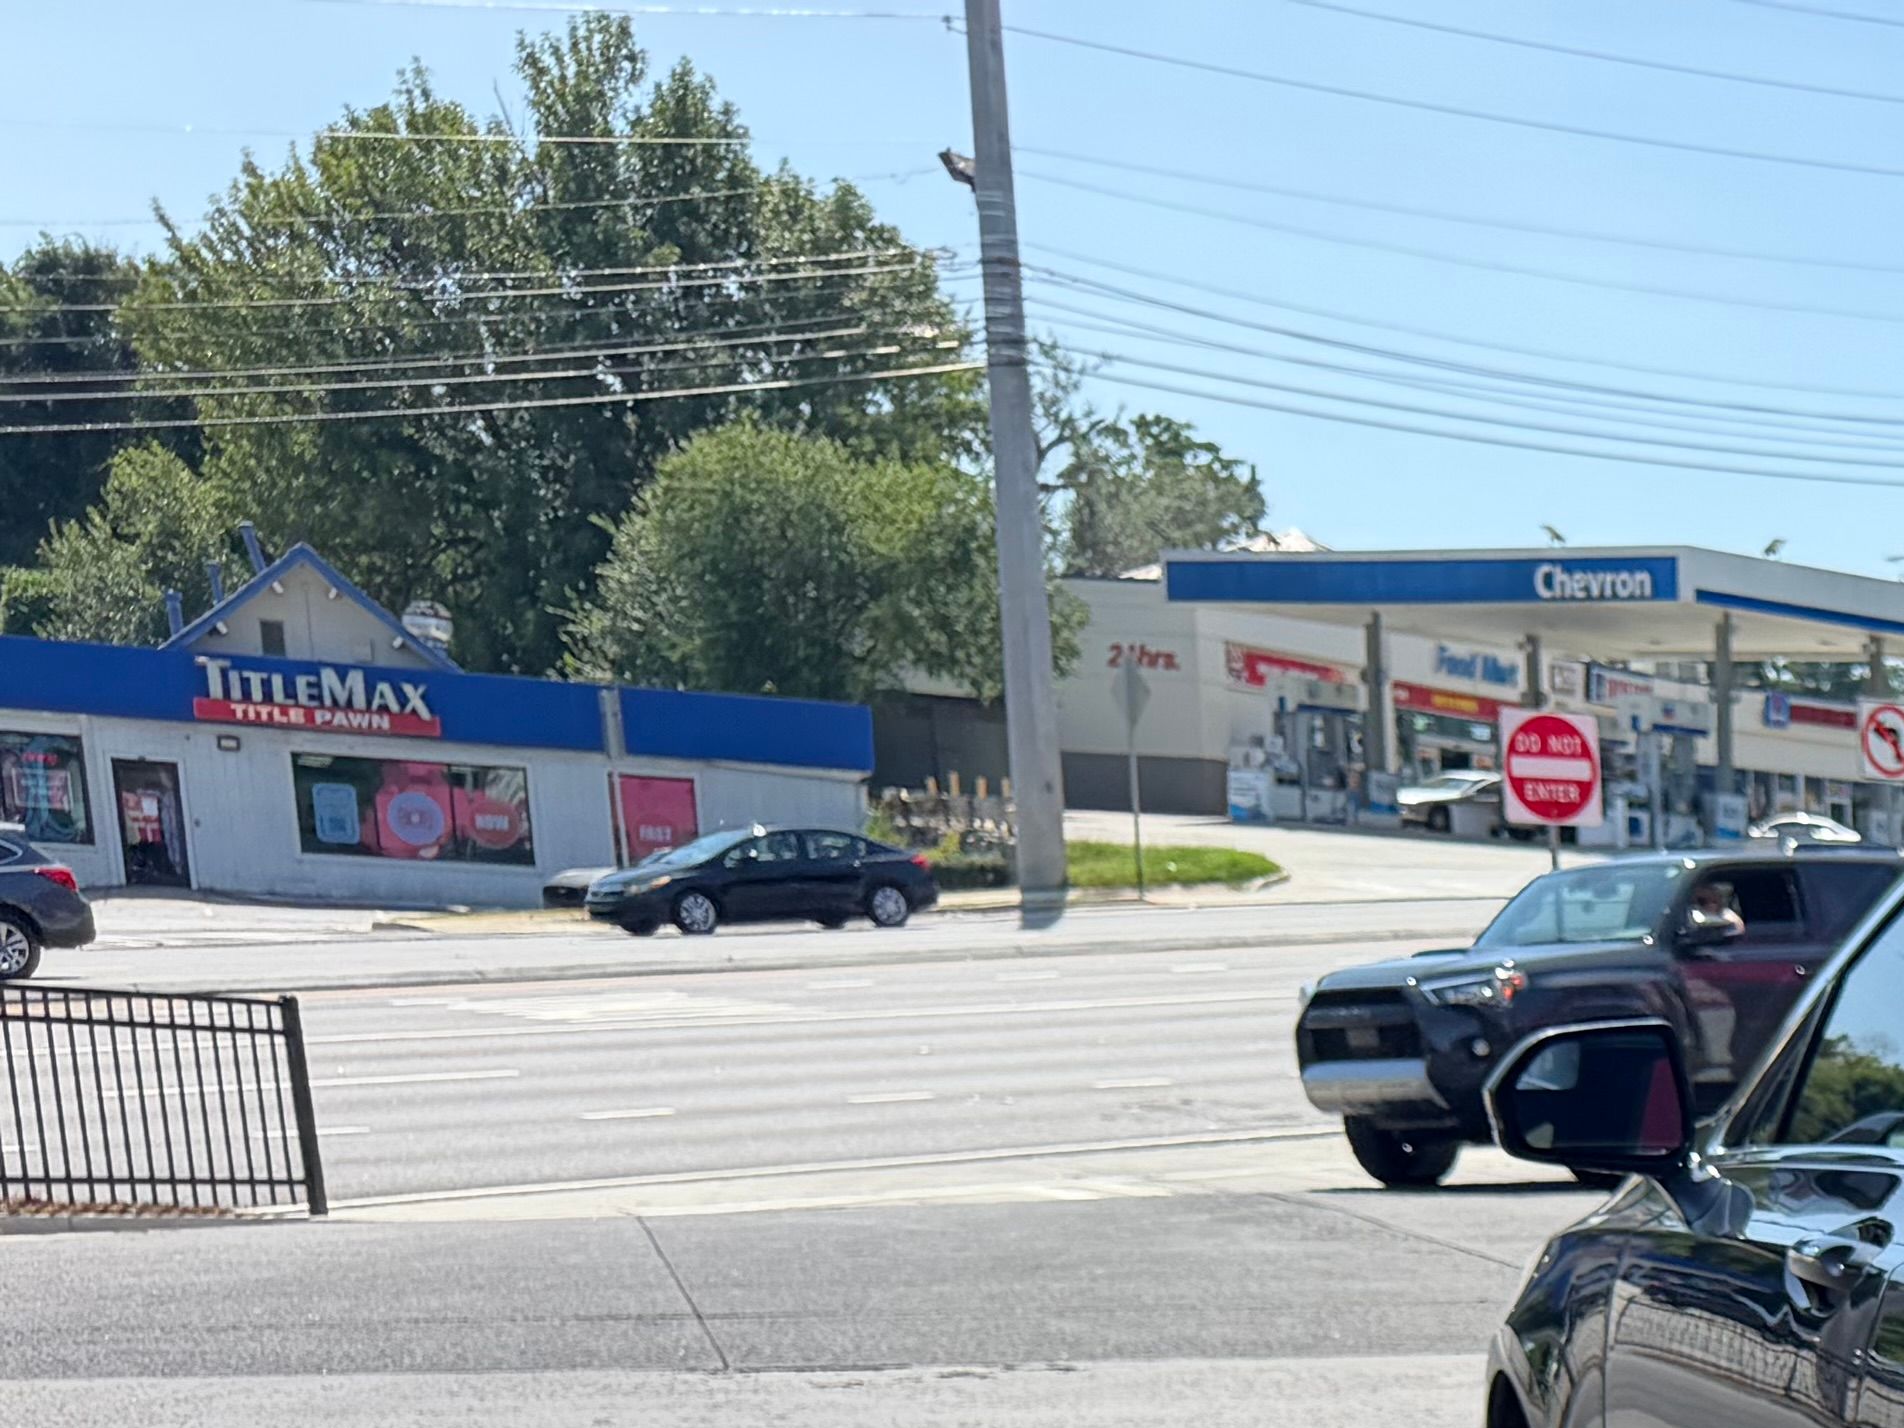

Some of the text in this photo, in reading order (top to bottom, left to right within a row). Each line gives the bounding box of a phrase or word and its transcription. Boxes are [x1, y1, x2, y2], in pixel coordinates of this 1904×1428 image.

[1533, 563, 1651, 599] Chevron
[231, 703, 390, 731] TITLE PAWN
[1515, 731, 1582, 755] DO NOT
[1523, 781, 1580, 803] ENTER
